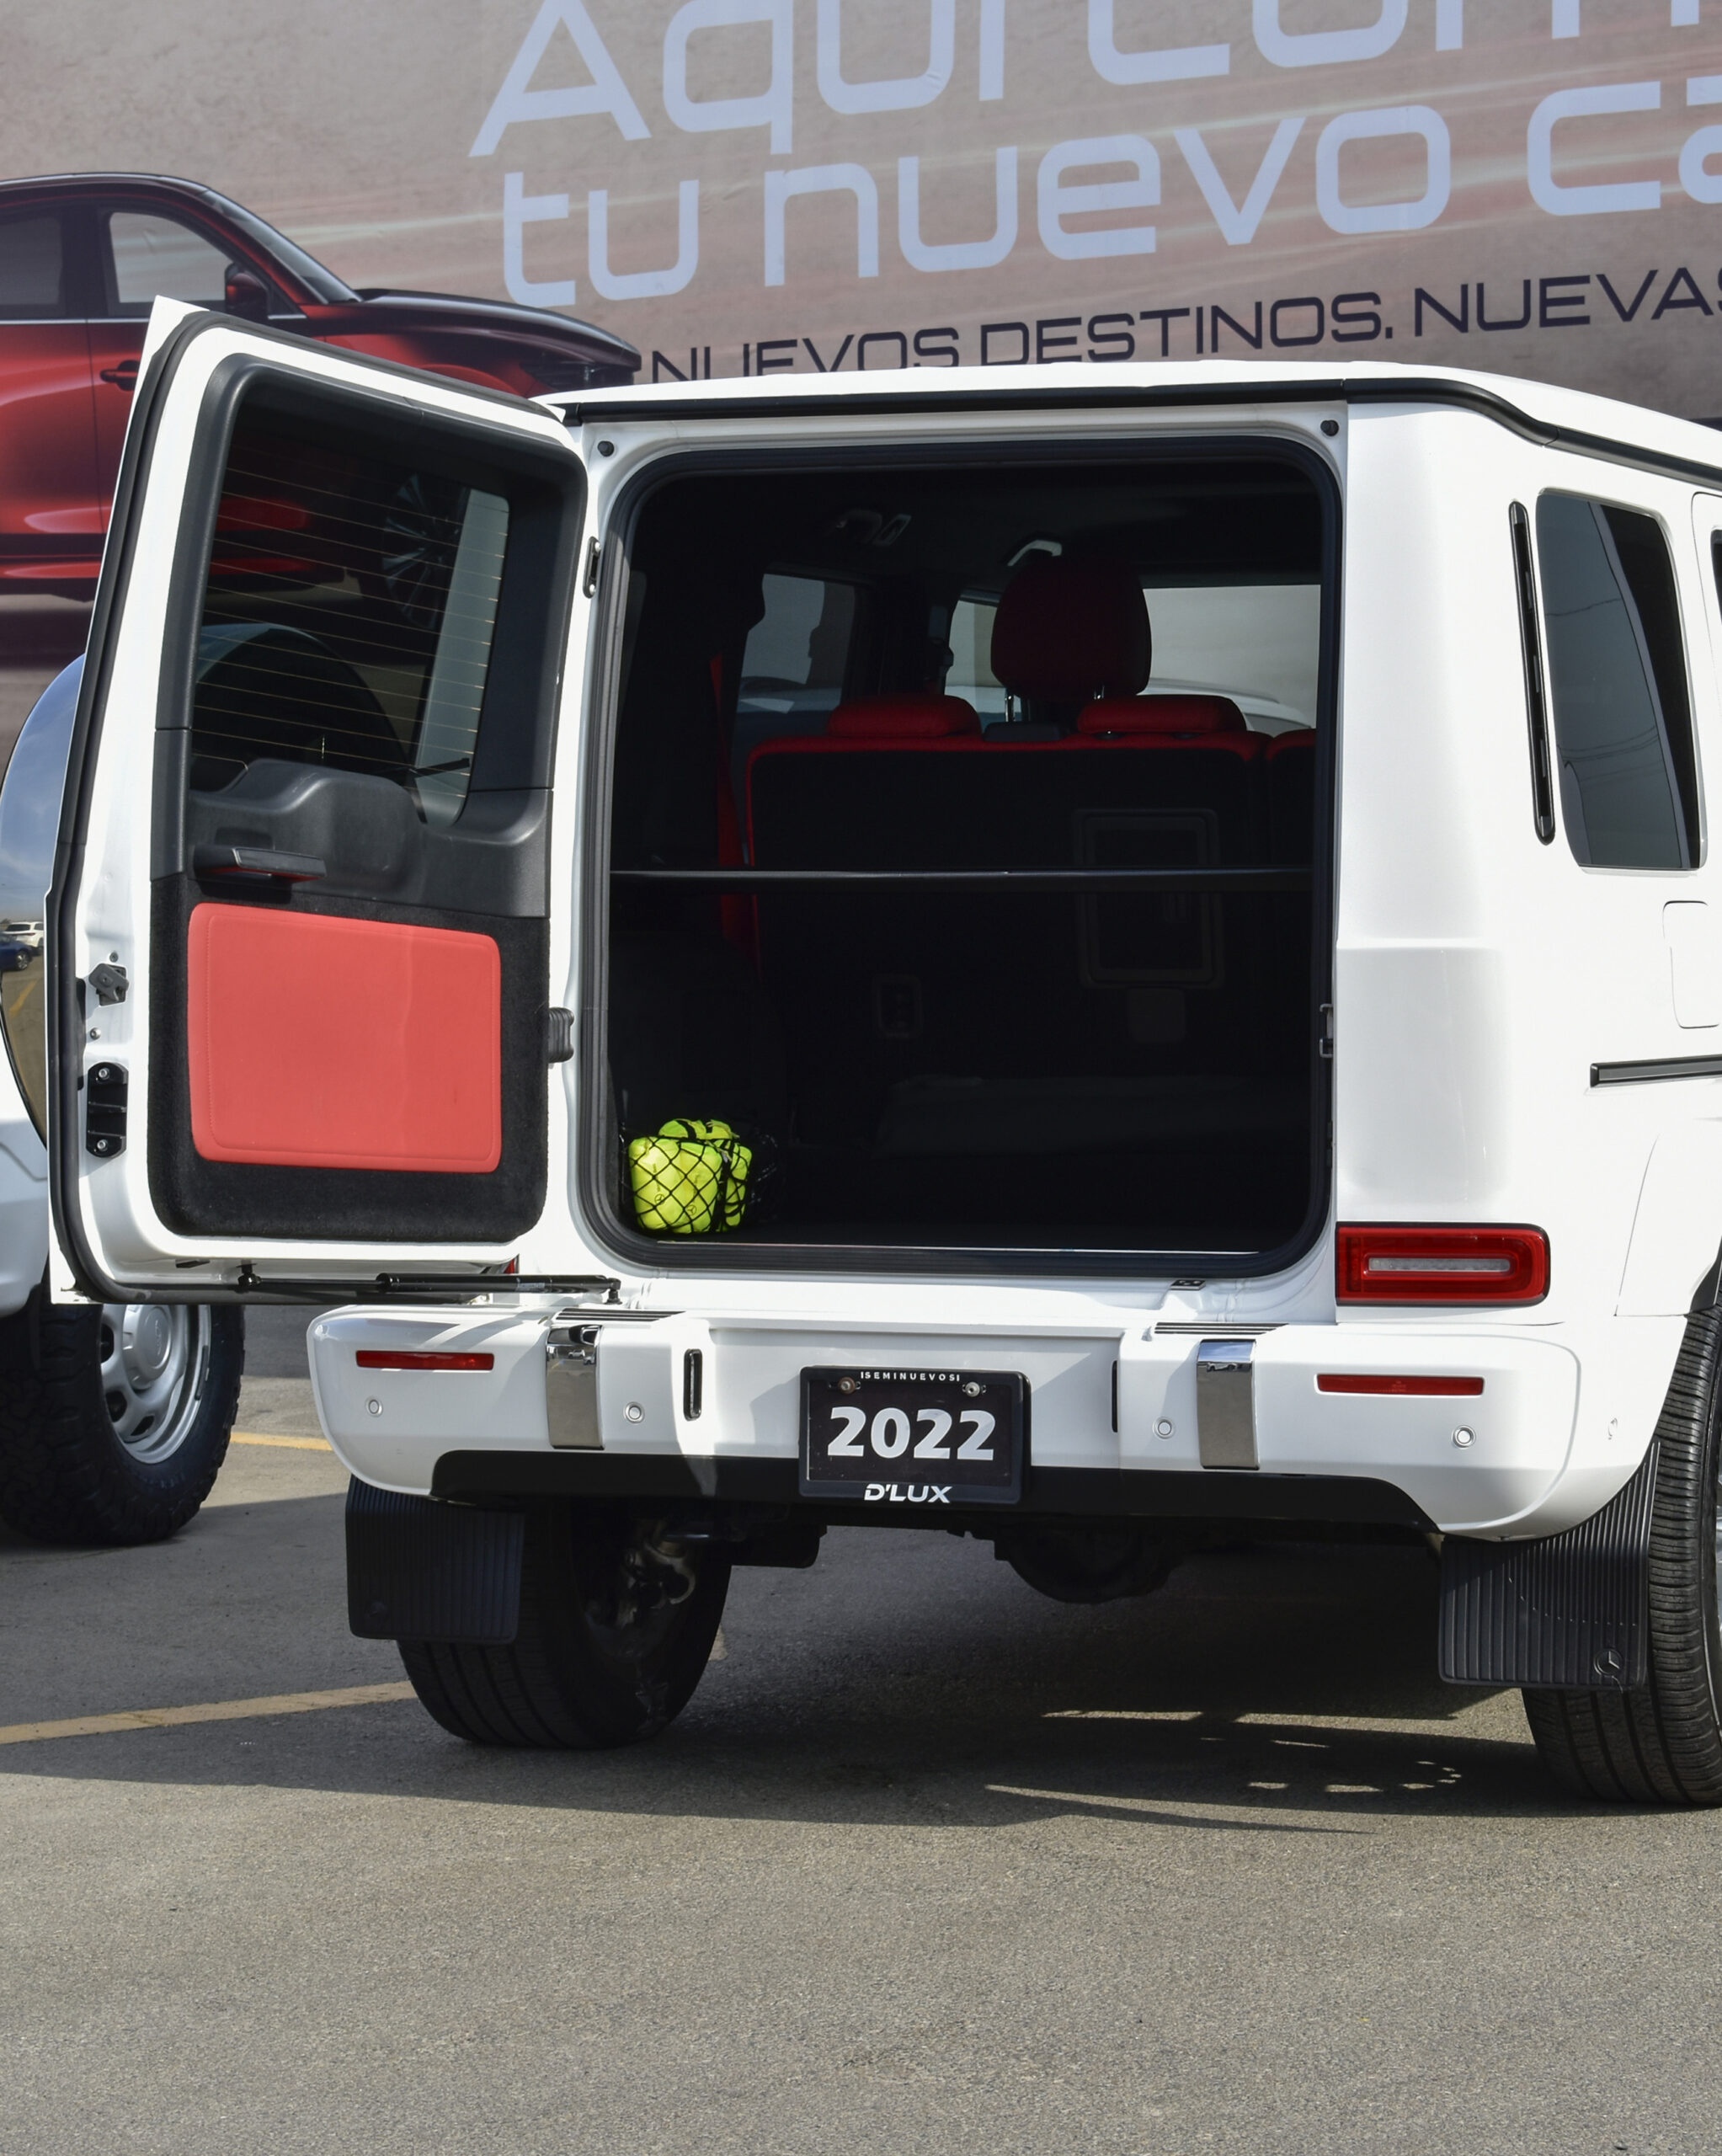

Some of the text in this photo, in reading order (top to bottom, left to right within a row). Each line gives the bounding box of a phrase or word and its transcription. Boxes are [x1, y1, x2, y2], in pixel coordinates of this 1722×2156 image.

[505, 172, 700, 308] tu
[764, 105, 1451, 287] nuevo
[1415, 267, 1722, 337] NUEVA
[827, 1406, 996, 1461] 2022
[863, 1483, 953, 1504] D'LUX
